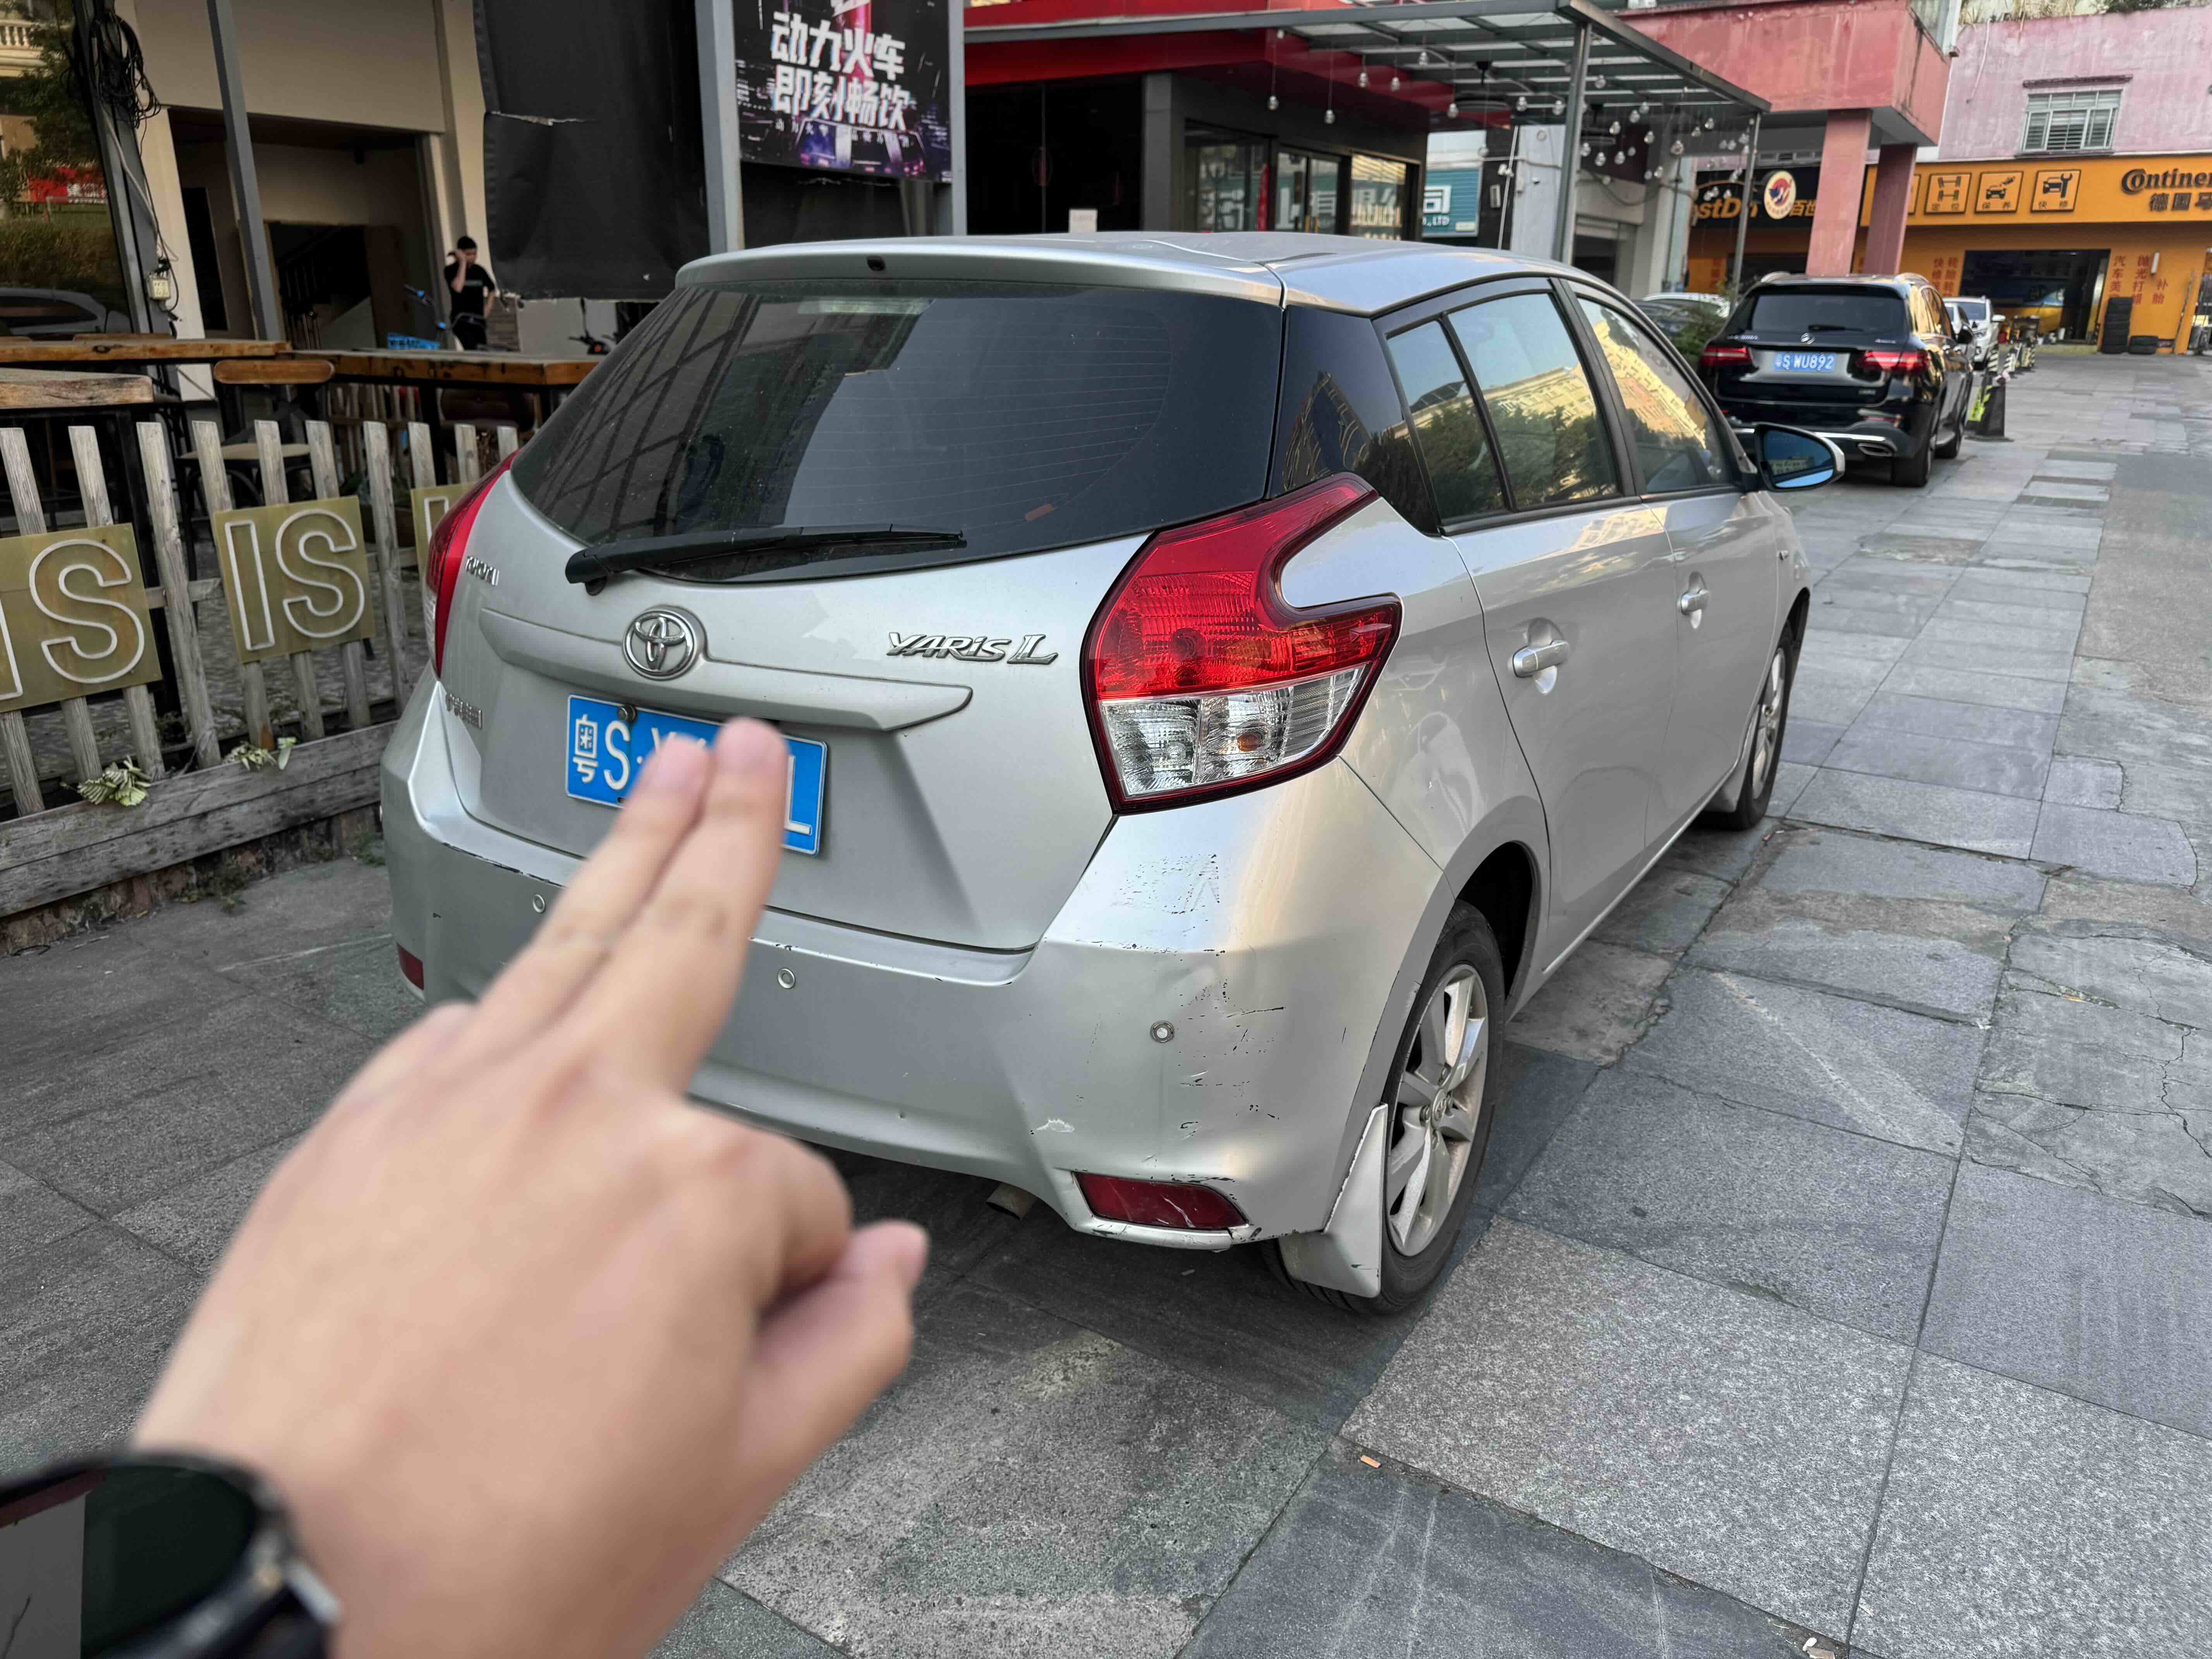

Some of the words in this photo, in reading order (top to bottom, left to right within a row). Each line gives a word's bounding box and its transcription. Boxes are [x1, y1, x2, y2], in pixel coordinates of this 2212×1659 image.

[770, 11, 905, 81] 动力火车
[772, 64, 911, 131] 即刻畅饮
[224, 508, 364, 651] IS
[1007, 634, 1058, 665] L
